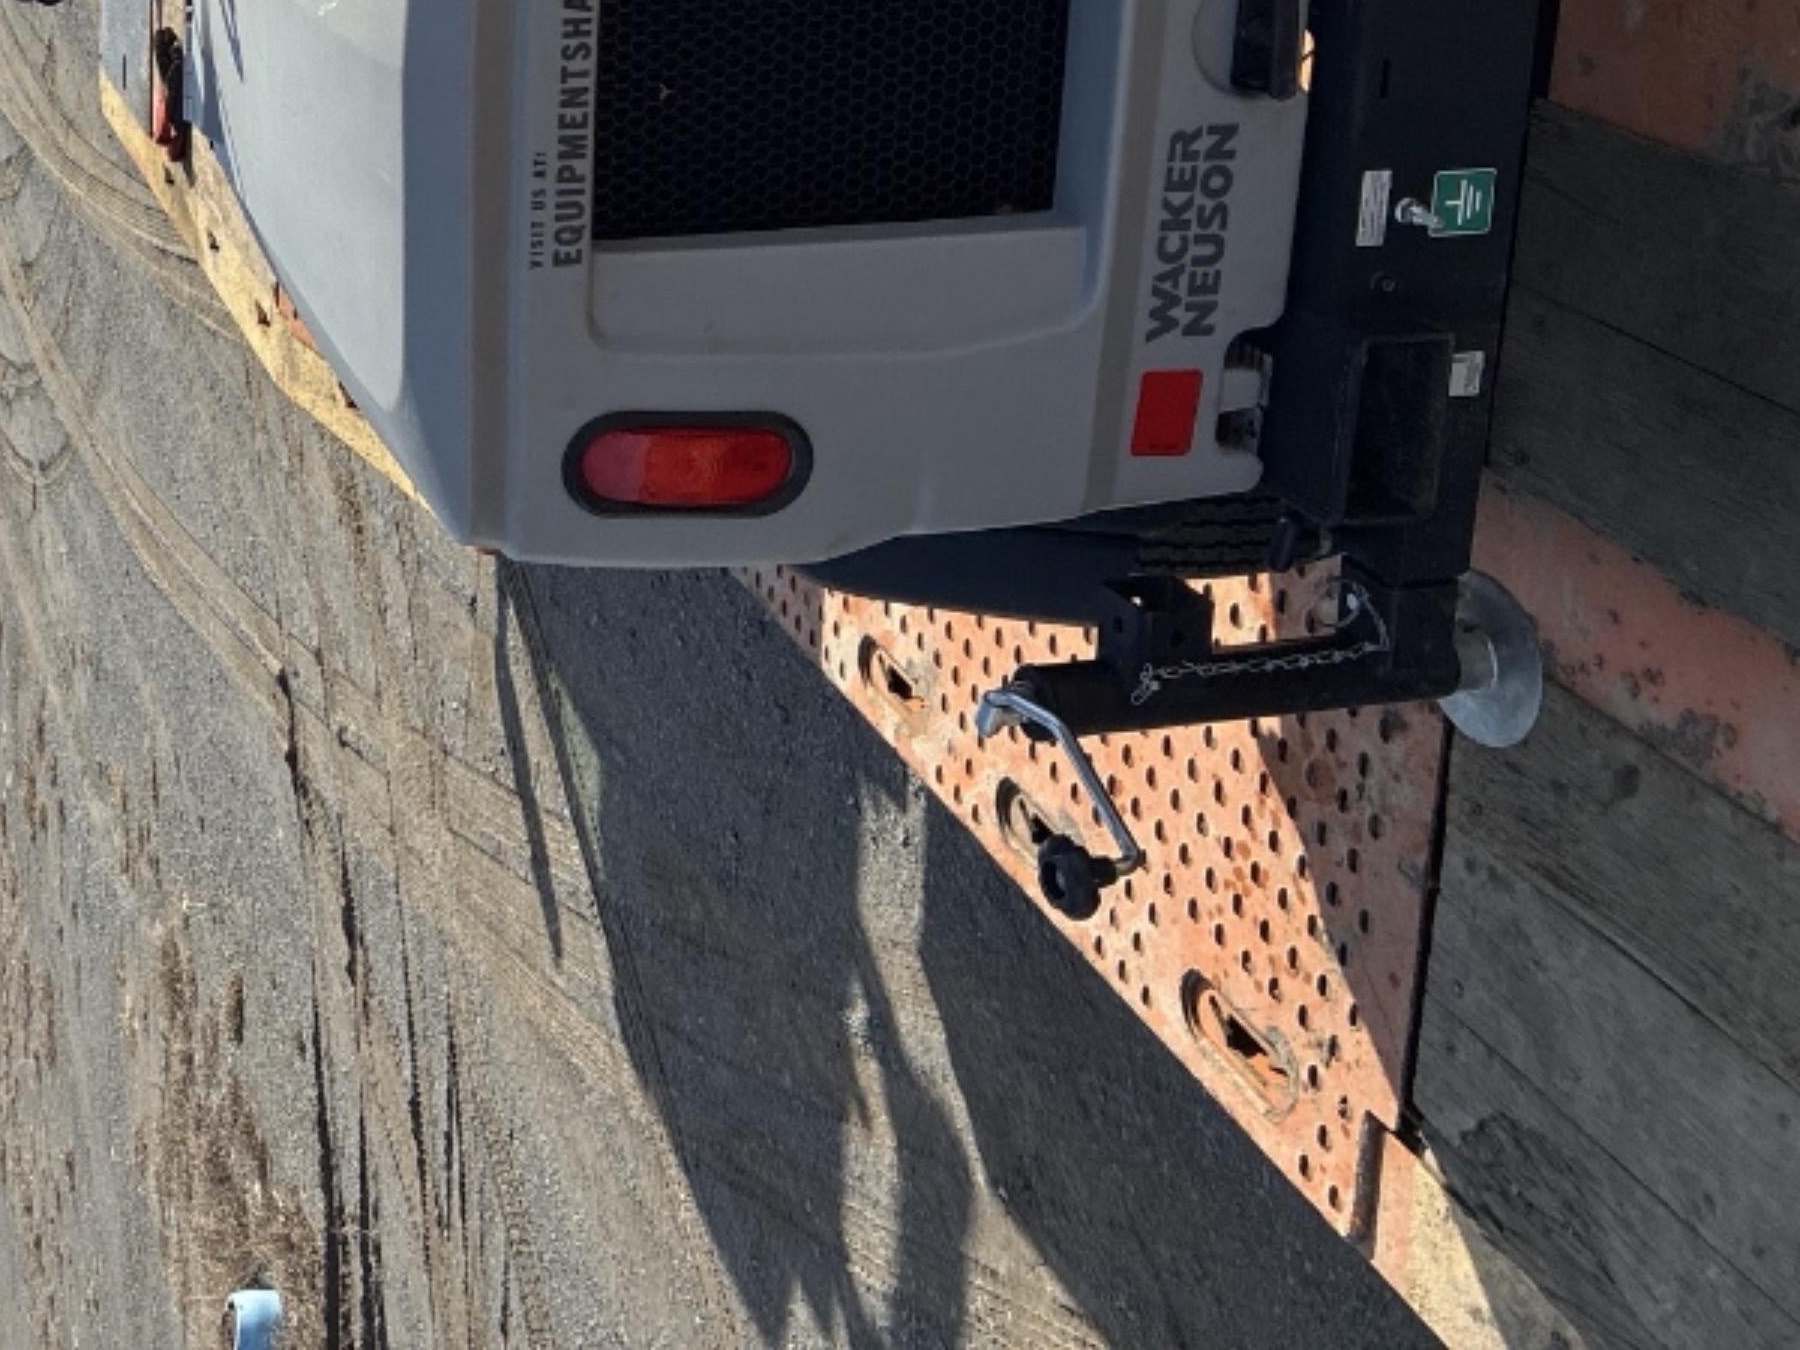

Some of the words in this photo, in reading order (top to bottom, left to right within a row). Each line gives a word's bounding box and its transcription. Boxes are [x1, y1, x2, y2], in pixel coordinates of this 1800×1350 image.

[529, 221, 546, 270] VISIT
[530, 187, 547, 211] US
[1145, 125, 1203, 343] WACKER
[1181, 123, 1240, 337] NEUSON
